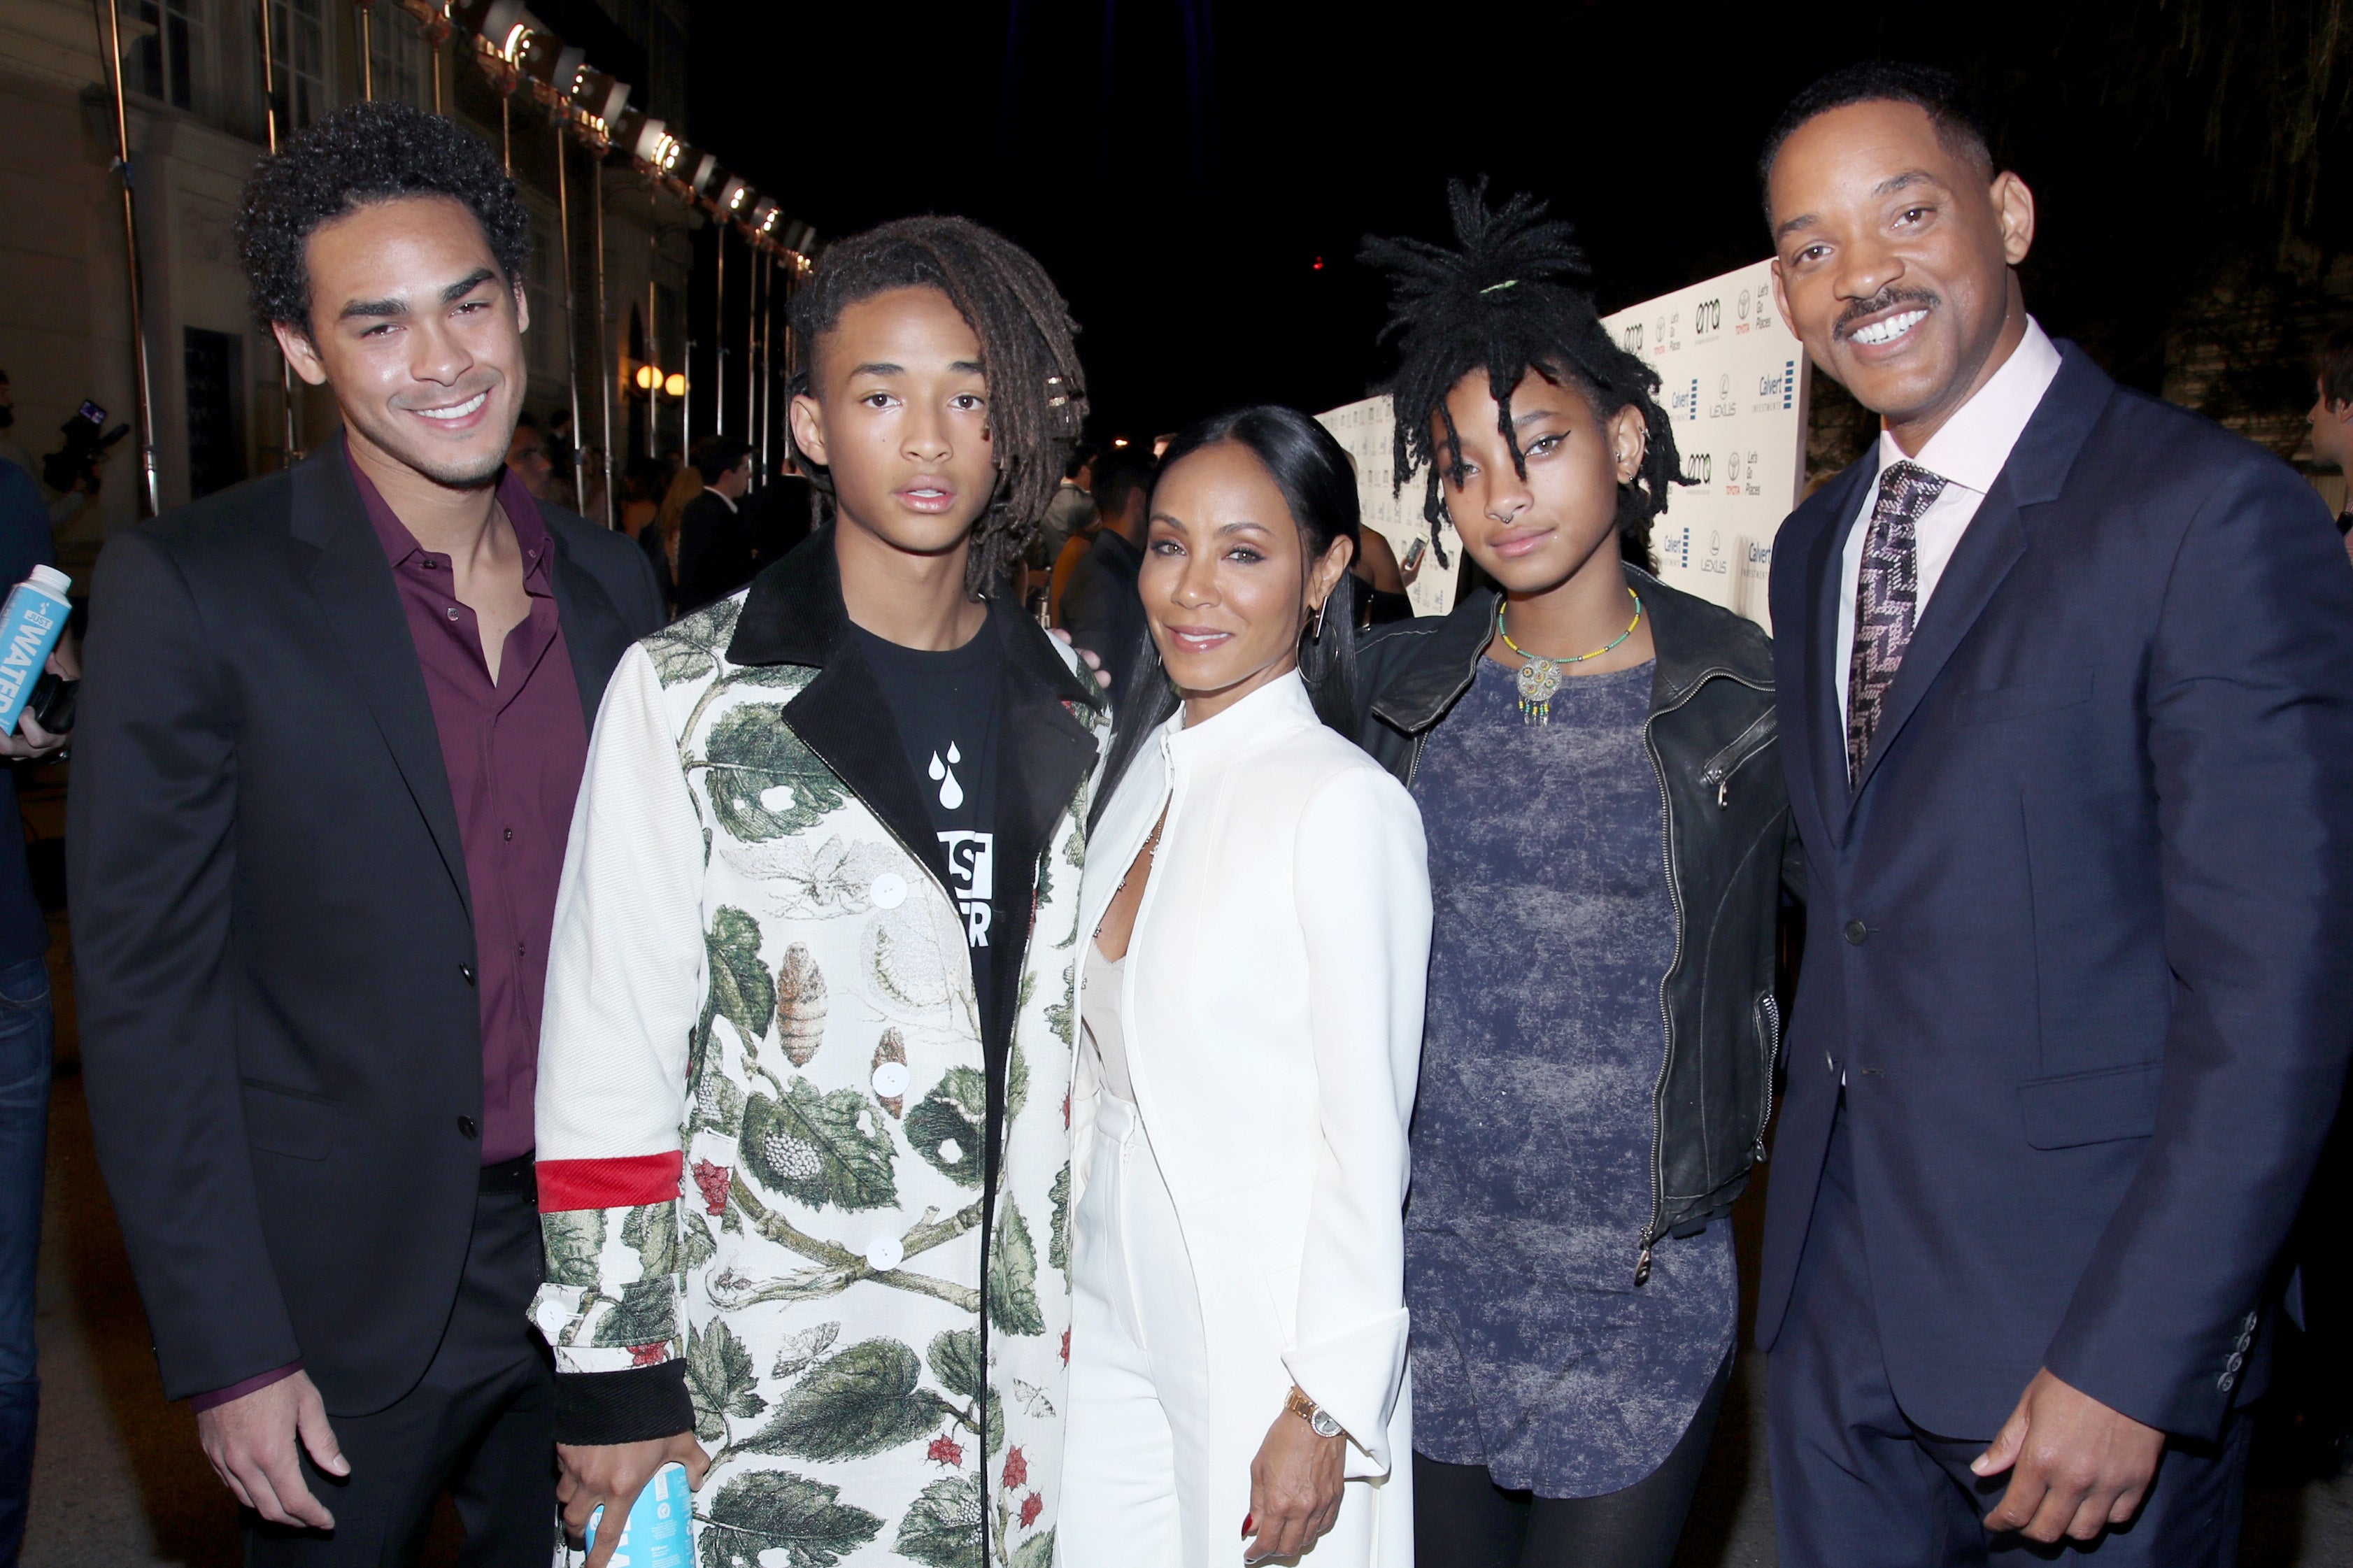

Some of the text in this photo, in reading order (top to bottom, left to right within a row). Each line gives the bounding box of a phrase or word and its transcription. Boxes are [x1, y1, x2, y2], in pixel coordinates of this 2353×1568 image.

[1757, 283, 1769, 298] Let's
[1756, 301, 1763, 313] Go
[1735, 322, 1750, 335] TOYOTA
[1756, 318, 1772, 329] Places
[1759, 373, 1782, 396] Calvert
[1672, 390, 1689, 409] Calvert
[1709, 402, 1736, 418] LEXUS
[1746, 483, 1761, 496] Places
[1664, 534, 1681, 553] Calvert
[1749, 541, 1771, 564] Calvert
[1700, 558, 1726, 574] LEXUS
[1741, 568, 1768, 578] INVESTMENT
[27, 613, 50, 628] JUST
